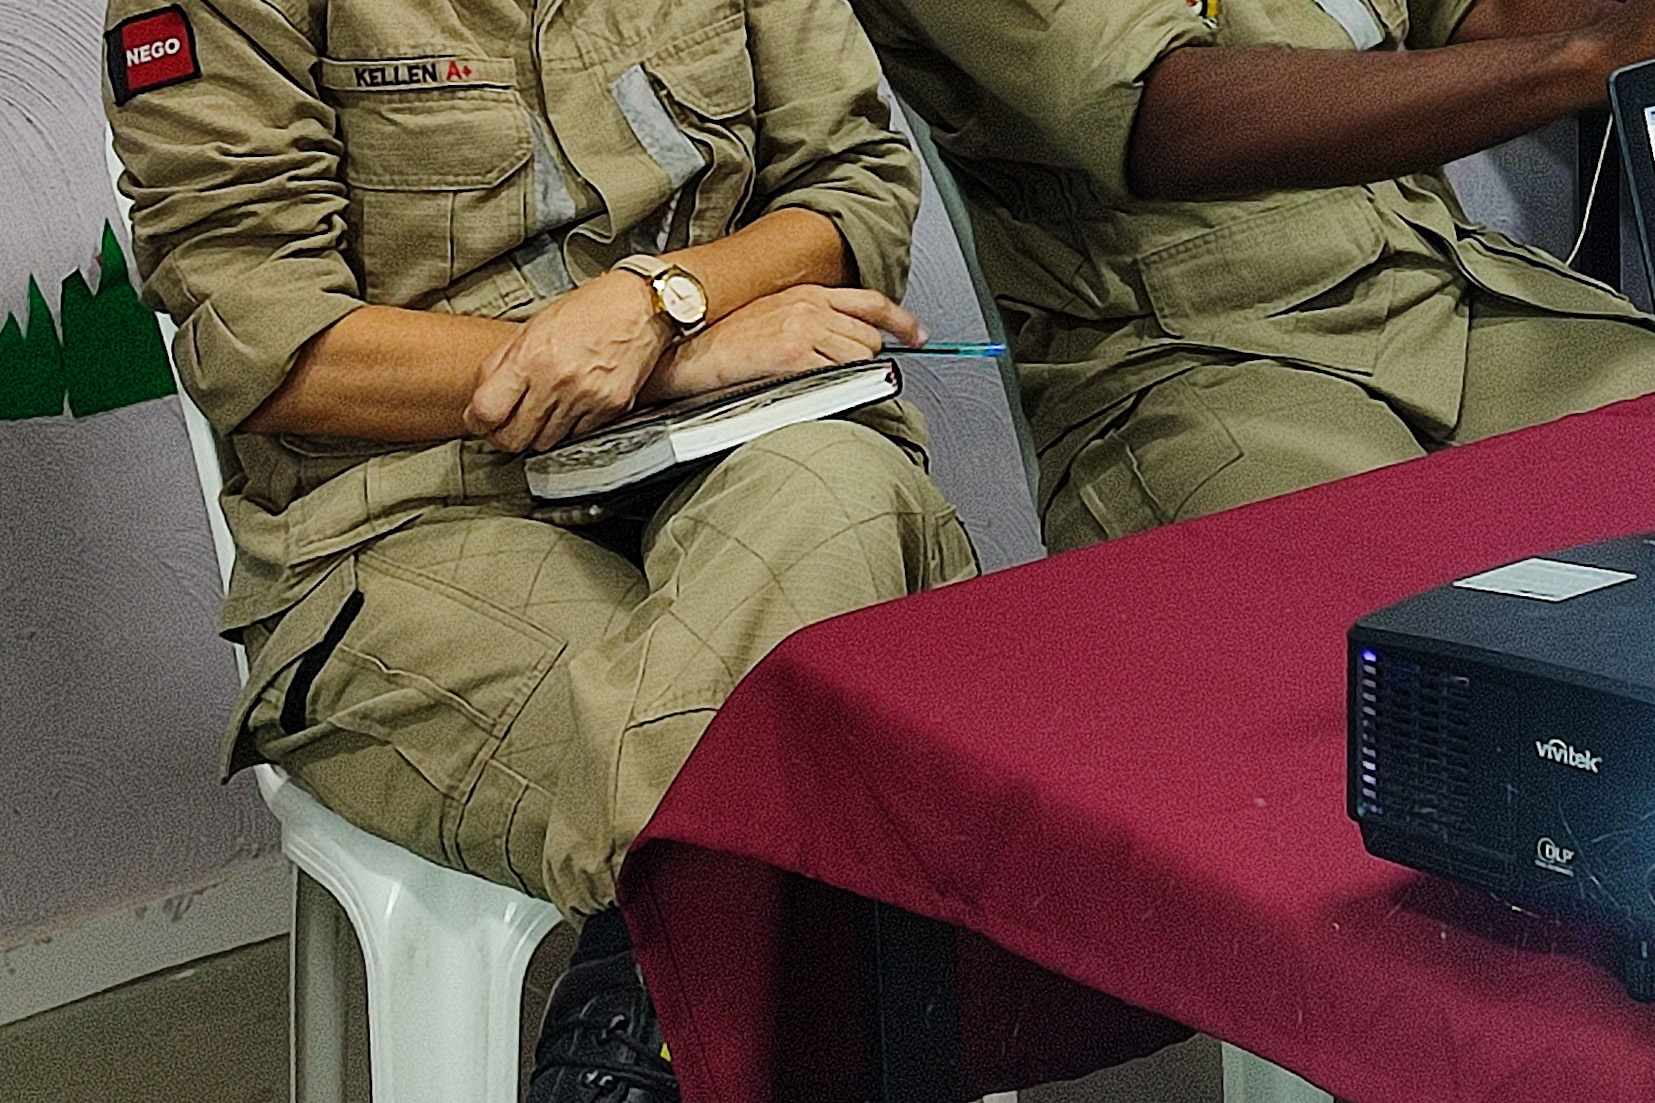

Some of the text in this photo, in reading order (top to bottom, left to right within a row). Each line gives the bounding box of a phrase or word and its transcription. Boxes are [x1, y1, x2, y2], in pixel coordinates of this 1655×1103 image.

[126, 38, 180, 67] NEGO
[354, 63, 438, 87] KELLEN
[1535, 739, 1602, 773] vivitek
